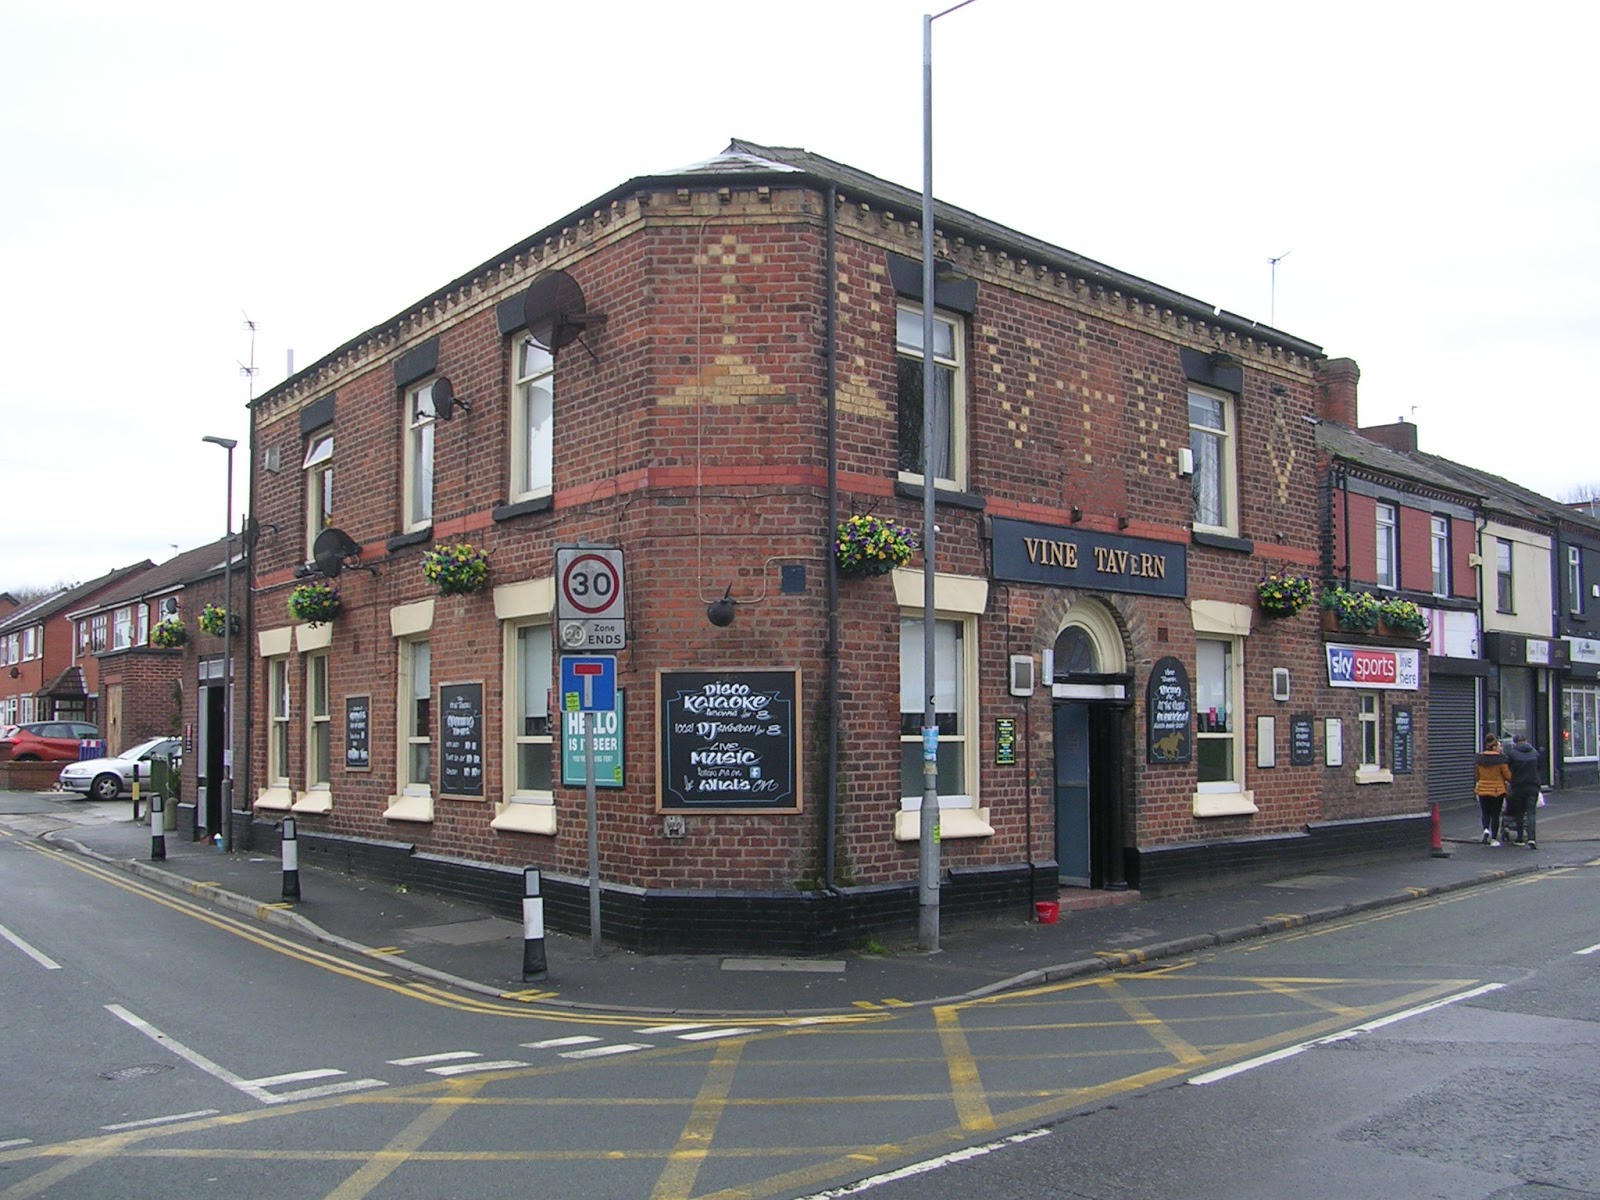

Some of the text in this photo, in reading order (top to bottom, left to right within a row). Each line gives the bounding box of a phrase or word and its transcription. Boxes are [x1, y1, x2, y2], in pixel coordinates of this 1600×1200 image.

[1023, 536, 1166, 579] VINE TAVERN
[572, 572, 611, 596] 30
[594, 624, 615, 632] Zone
[588, 635, 621, 644] ENDS
[1332, 651, 1395, 680] sky sports
[568, 712, 618, 735] HELO
[696, 722, 721, 740] DJ
[569, 738, 578, 751] IS
[690, 749, 762, 765] Music
